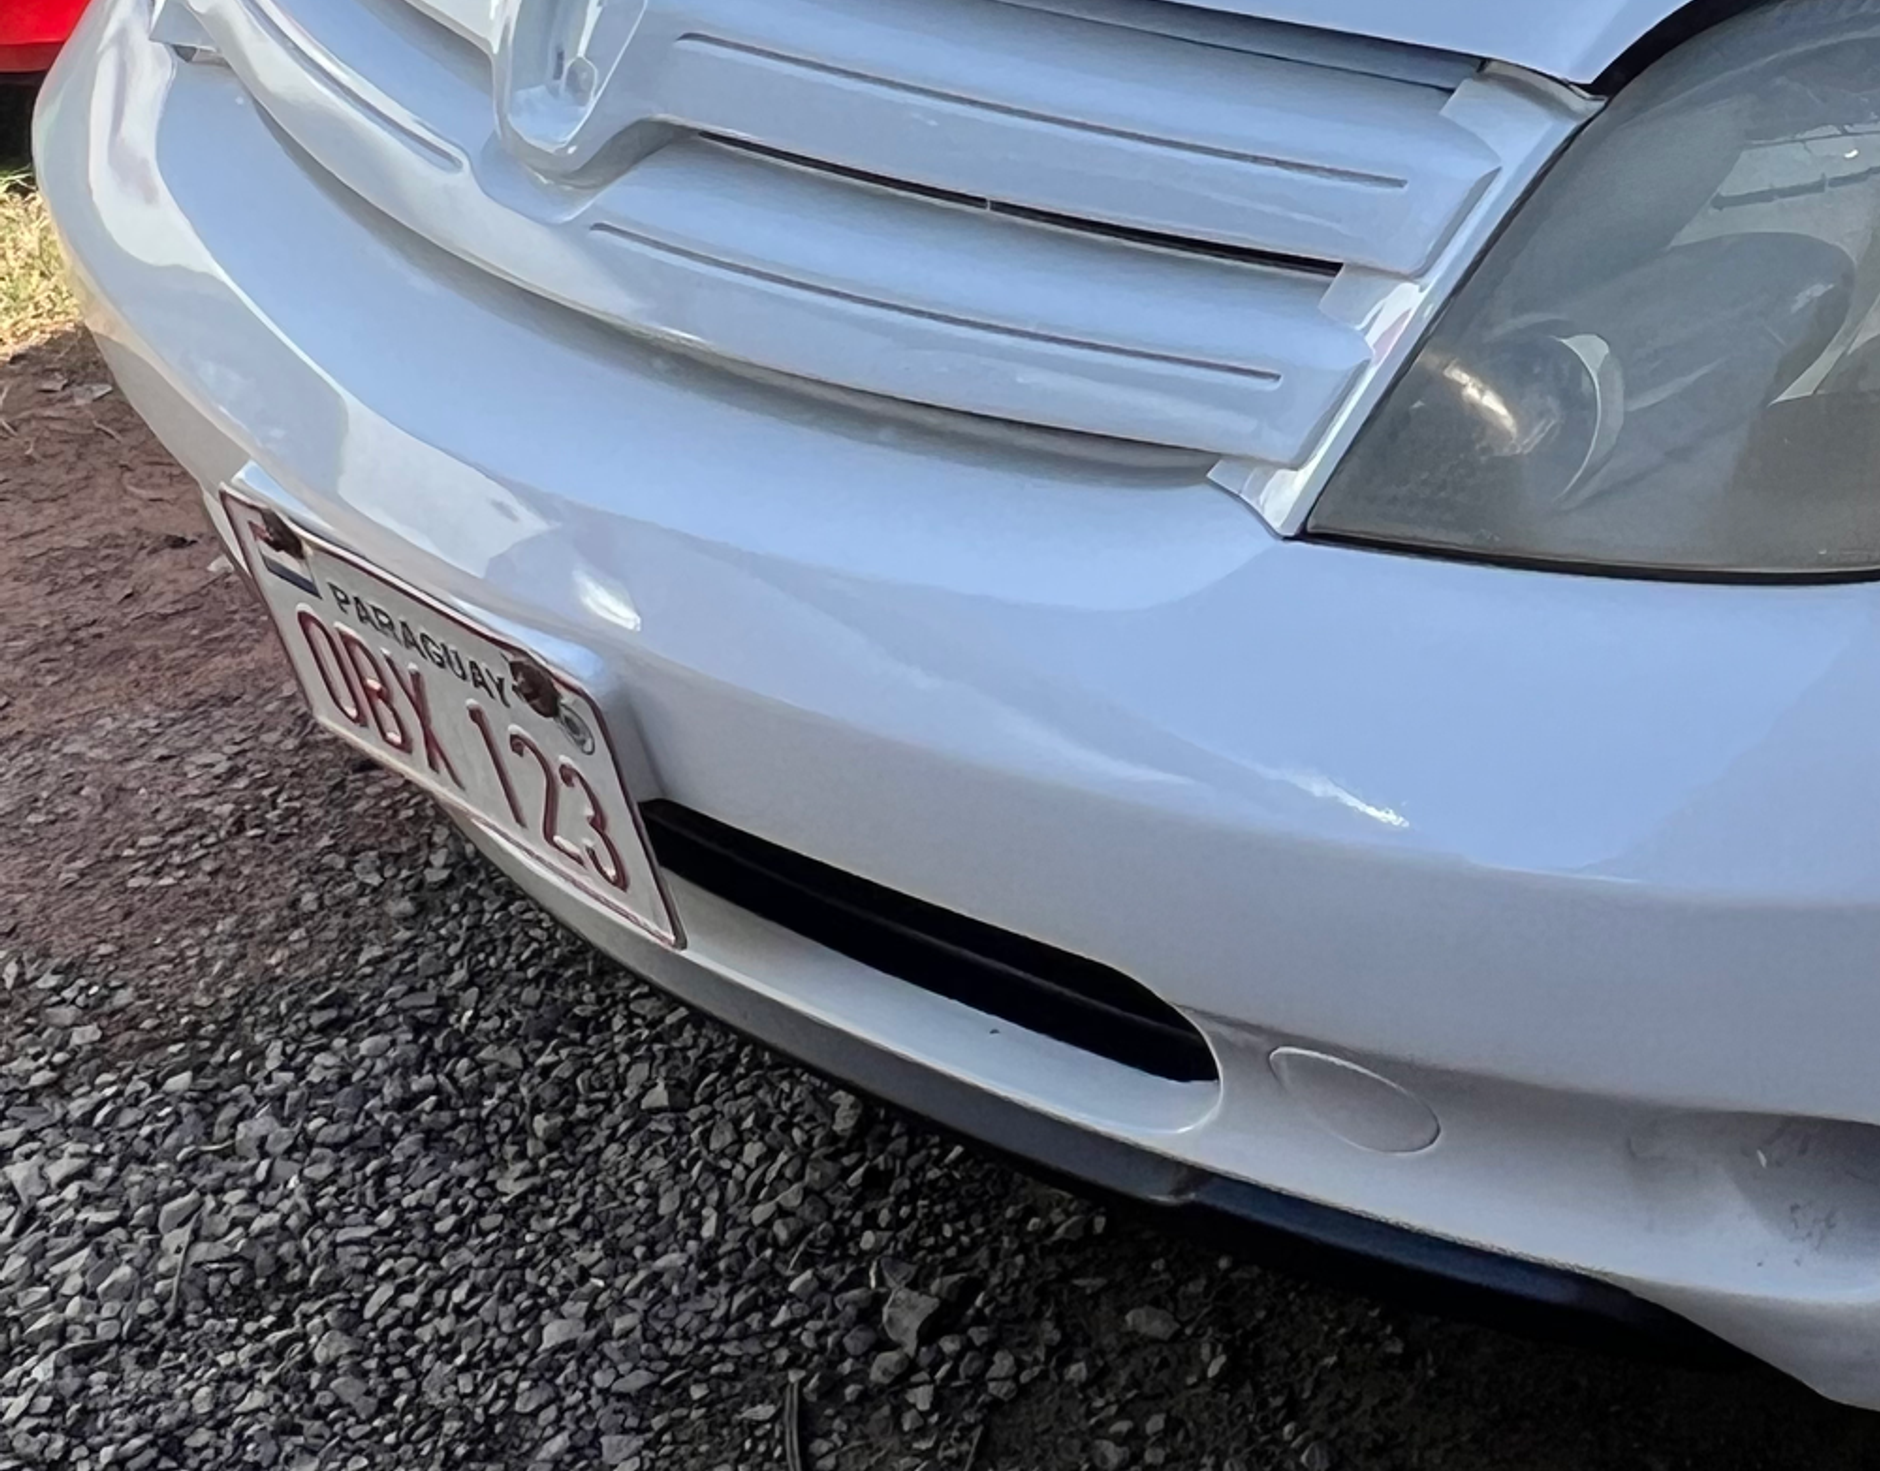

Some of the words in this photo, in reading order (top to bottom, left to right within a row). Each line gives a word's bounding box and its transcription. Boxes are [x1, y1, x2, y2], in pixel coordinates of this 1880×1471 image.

[297, 605, 465, 791] OBX
[467, 699, 630, 893] 123
[327, 581, 511, 709] PARAGUAY
